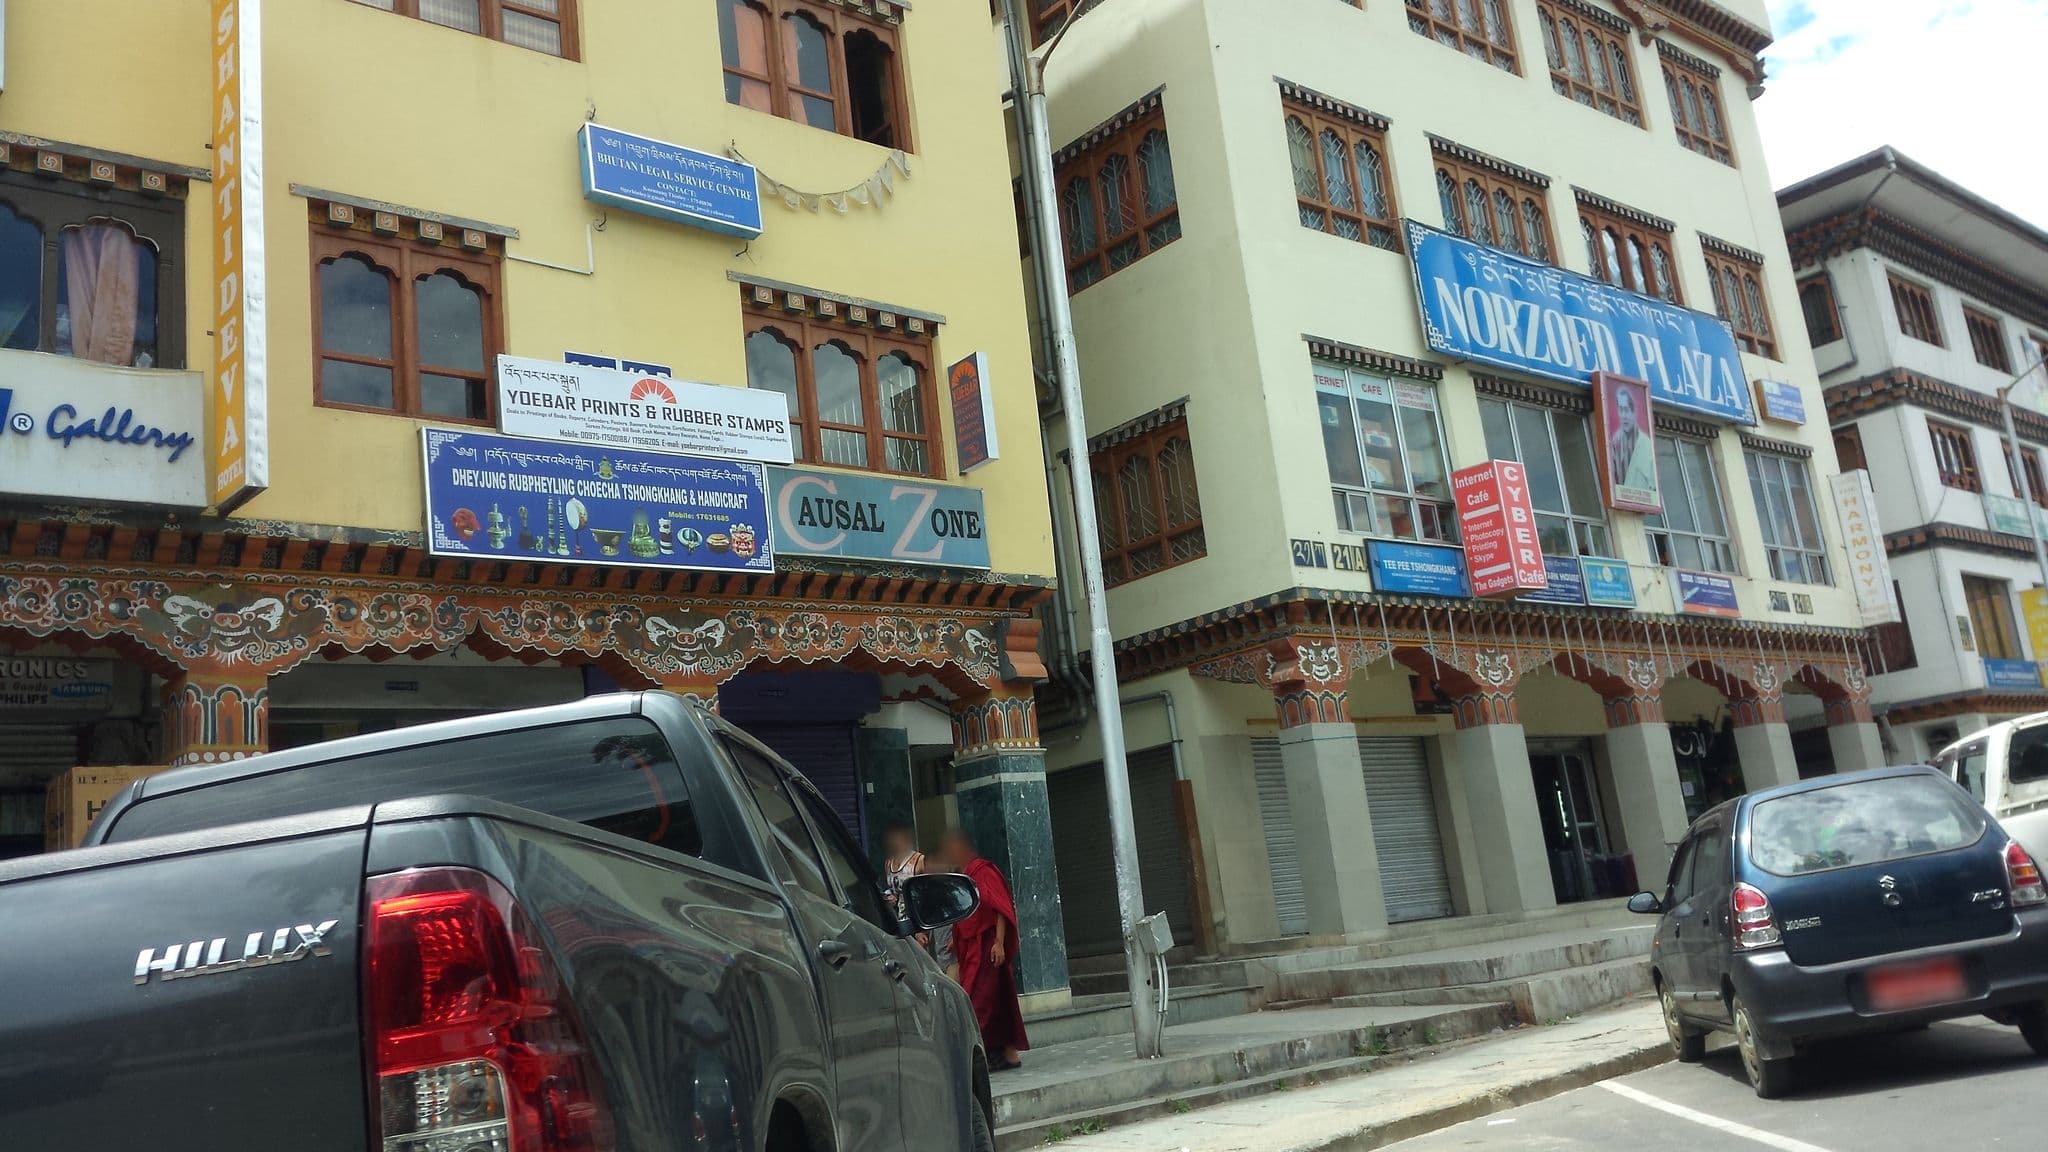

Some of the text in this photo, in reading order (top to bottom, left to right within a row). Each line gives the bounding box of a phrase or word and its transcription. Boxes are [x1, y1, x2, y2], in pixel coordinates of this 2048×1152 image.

[597, 152, 638, 172] BHUTAN
[640, 163, 673, 181] LEGAL
[674, 172, 715, 192] SERVICE
[716, 182, 753, 201] CENTRE
[217, 1, 241, 457] SHANTIDEVA
[1433, 276, 1744, 410] NORZOED PLAZA
[1361, 383, 1382, 396] CAFE
[507, 389, 785, 434] YOEBAR PRINTS & RUBBER STAMPS
[46, 403, 194, 463] Gallery
[216, 462, 243, 493] HOTEL
[452, 468, 748, 510] DHEYJUNG RUBPHEYLING CHOECHA TSHONGKHANG & HANDICRAFT
[1455, 468, 1494, 489] Internet
[1467, 491, 1489, 505] Café
[777, 475, 981, 560] CAUSAL ZONE
[1468, 519, 1493, 532] Internet
[1503, 466, 1536, 565] CYBER
[1470, 527, 1505, 543] Photocopy
[1472, 540, 1498, 552] Printing
[1842, 495, 1873, 588] HARMONY
[1333, 545, 1367, 571] 21A
[1474, 552, 1494, 563] Skype
[1475, 575, 1514, 591] The Gadgets
[1519, 568, 1545, 584] Café
[134, 919, 339, 985] HILUX
